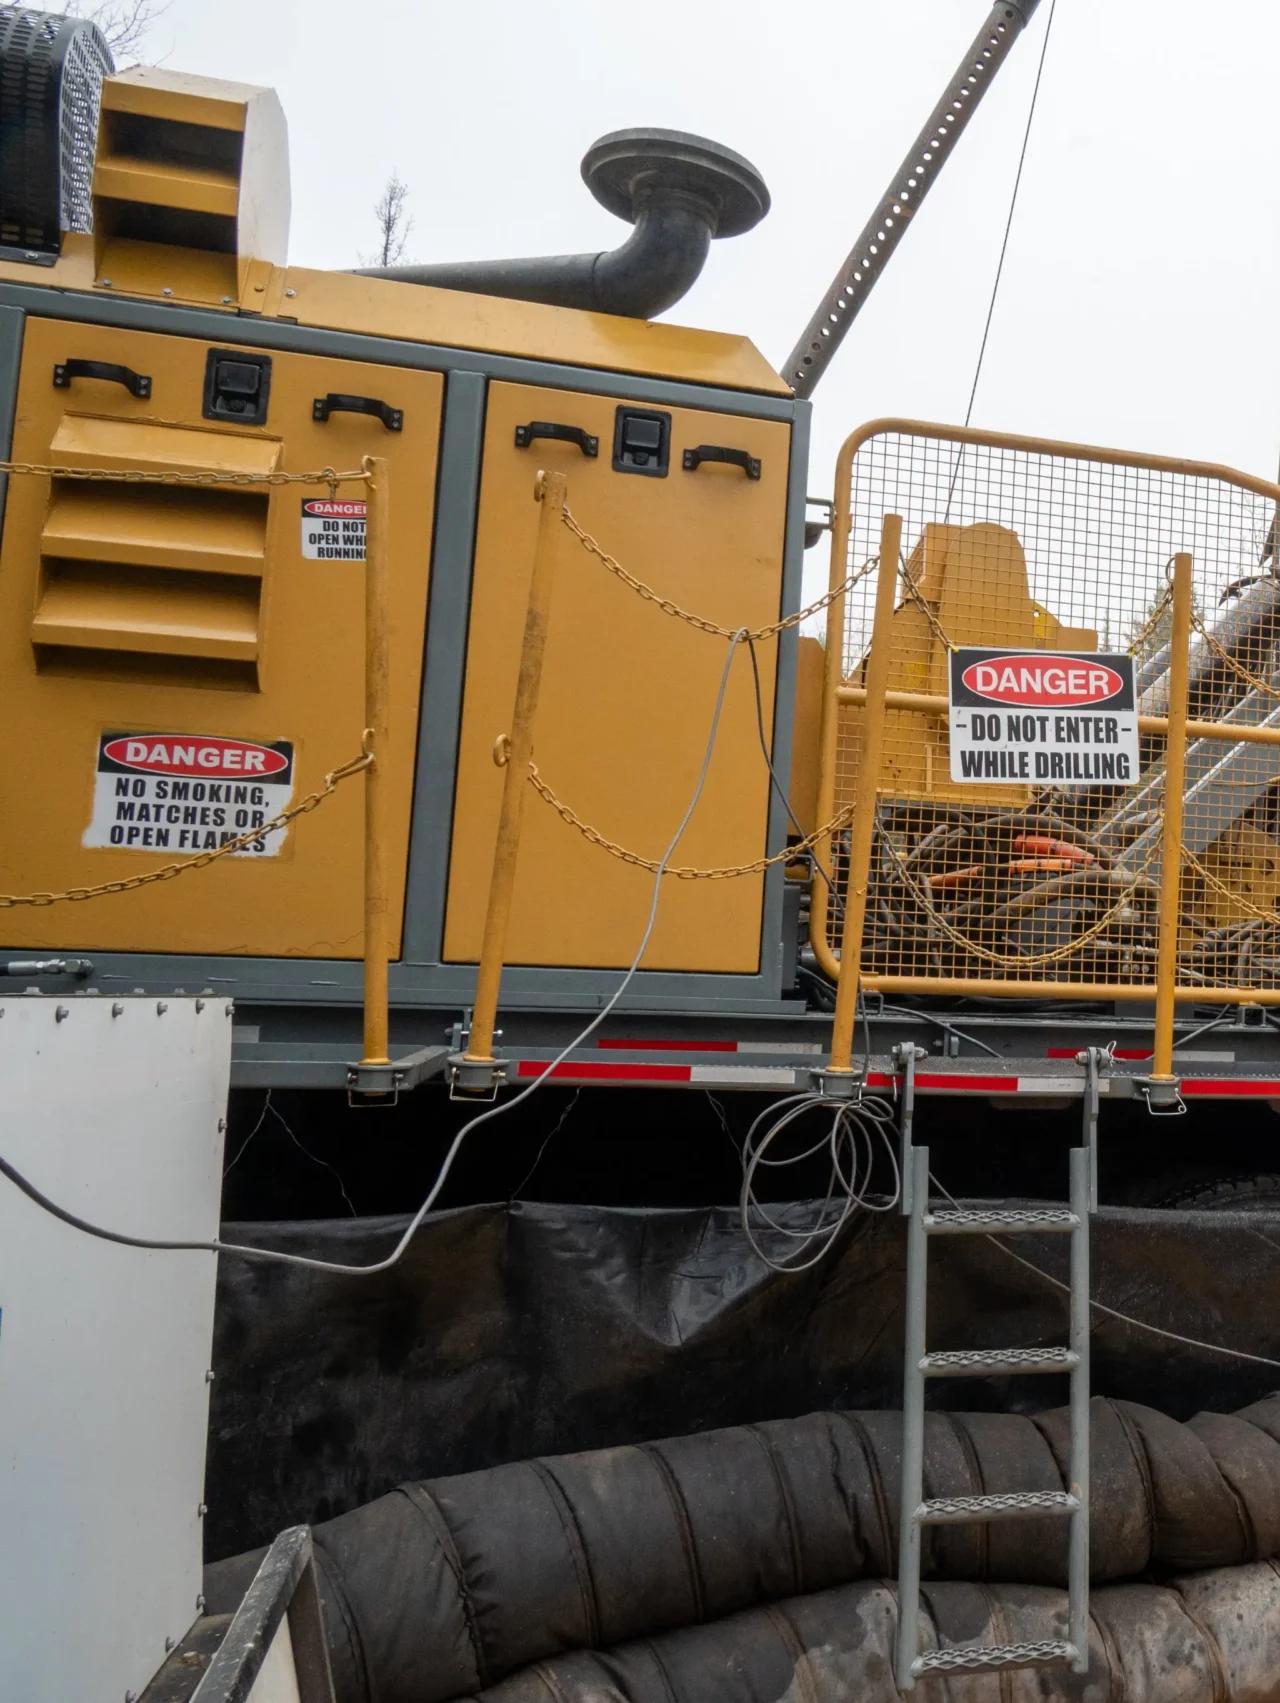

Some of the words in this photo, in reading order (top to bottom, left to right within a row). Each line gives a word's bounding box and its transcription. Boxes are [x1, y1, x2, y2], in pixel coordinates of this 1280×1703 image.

[314, 503, 366, 514] DANGE
[308, 533, 339, 545] OPEN
[323, 520, 339, 532] DO
[342, 521, 366, 533] NOT
[317, 547, 366, 559] RUNNIN
[975, 666, 1109, 695] DANGER
[971, 713, 1000, 741] DO
[1007, 714, 1049, 743] NOT
[1055, 716, 1118, 744] ENTER
[125, 742, 266, 771] DANGER
[960, 750, 1029, 779] WHILE
[1034, 752, 1130, 780] DRILLING
[115, 777, 146, 798] NO
[155, 780, 270, 808] SMOKING,
[116, 801, 226, 827] MATCHES
[235, 809, 264, 829] OR
[110, 825, 170, 847] OPEN
